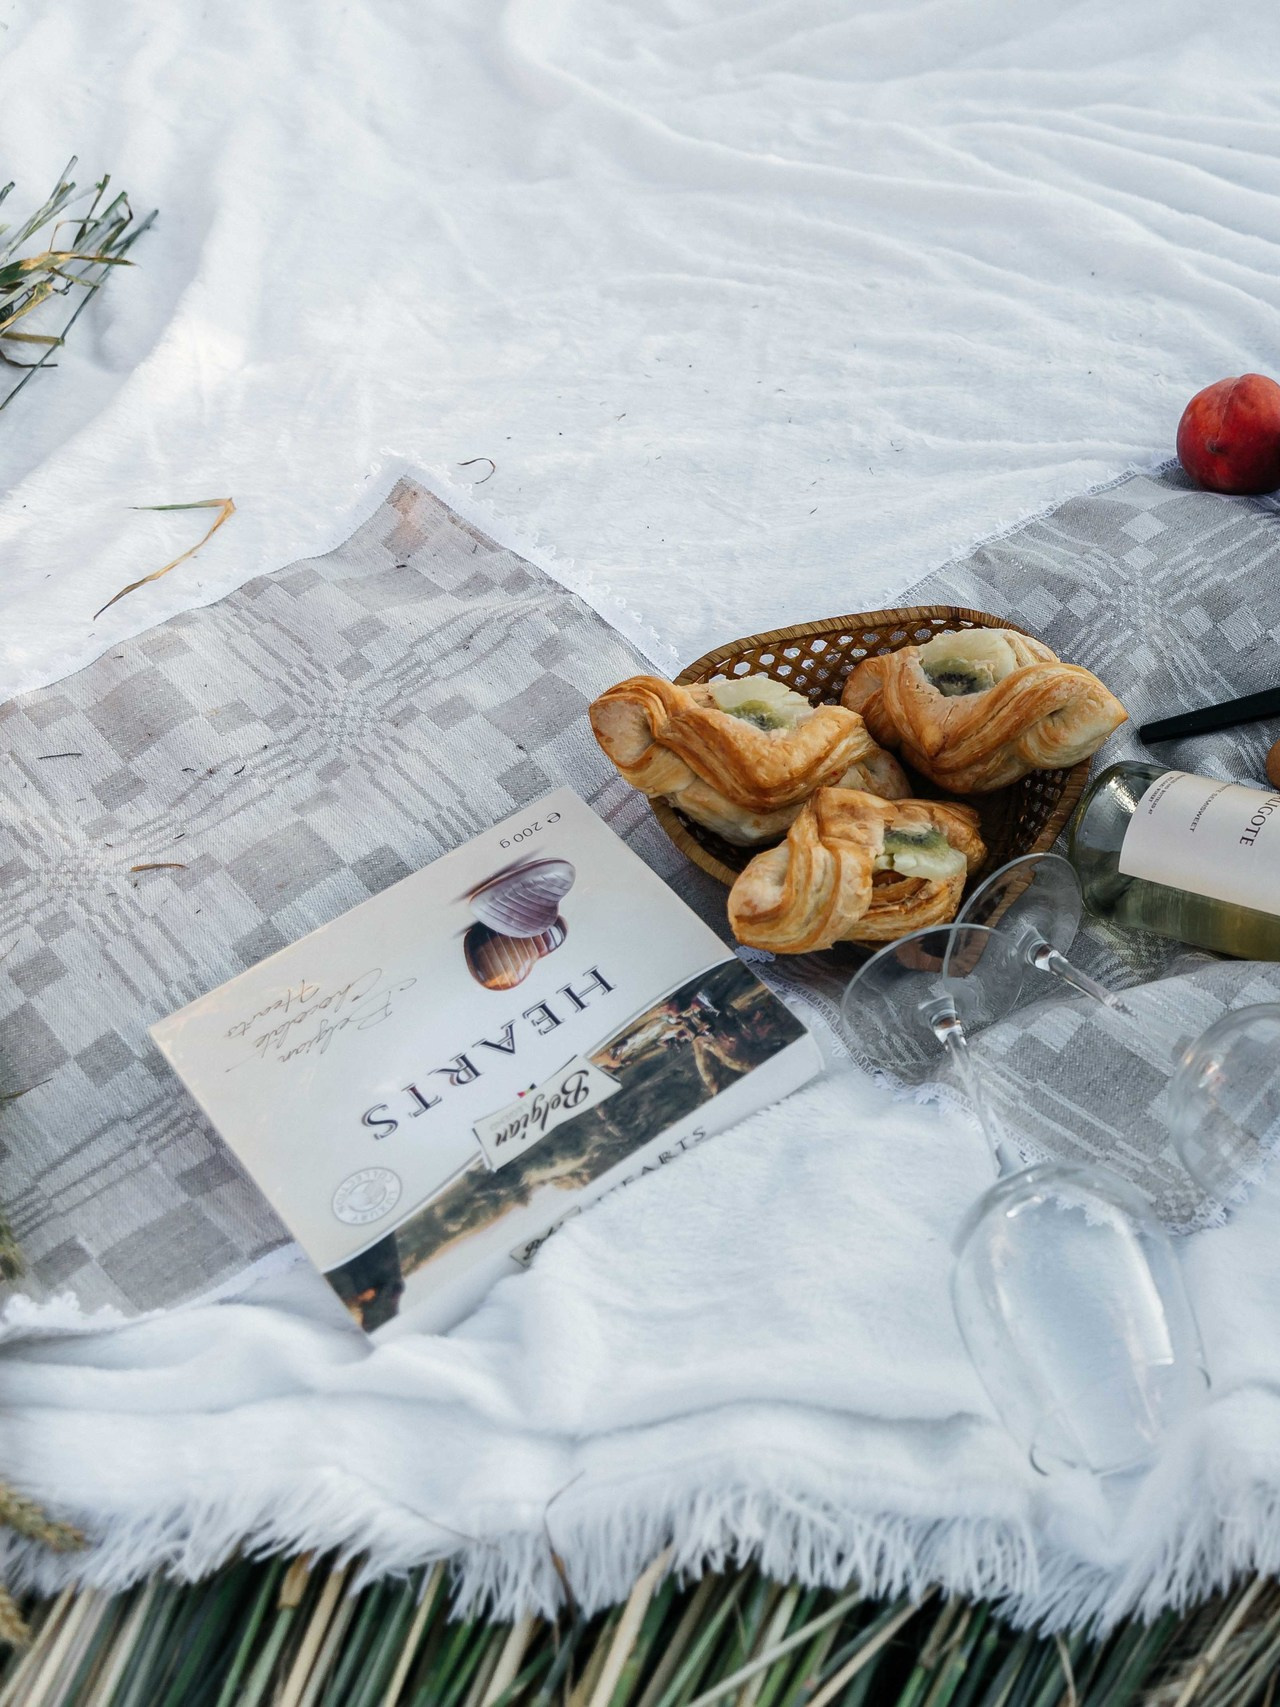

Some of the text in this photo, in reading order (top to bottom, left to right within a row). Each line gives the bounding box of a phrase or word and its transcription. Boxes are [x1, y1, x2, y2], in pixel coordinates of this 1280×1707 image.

[499, 838, 511, 849] g
[513, 821, 543, 843] 200
[1190, 793, 1217, 832] SEMISWEET
[224, 979, 320, 1039] Hearts
[225, 967, 382, 1073] Chocolate
[278, 977, 417, 1063] Belgian
[361, 965, 617, 1140] HEARTS
[494, 1069, 589, 1147] Belgian
